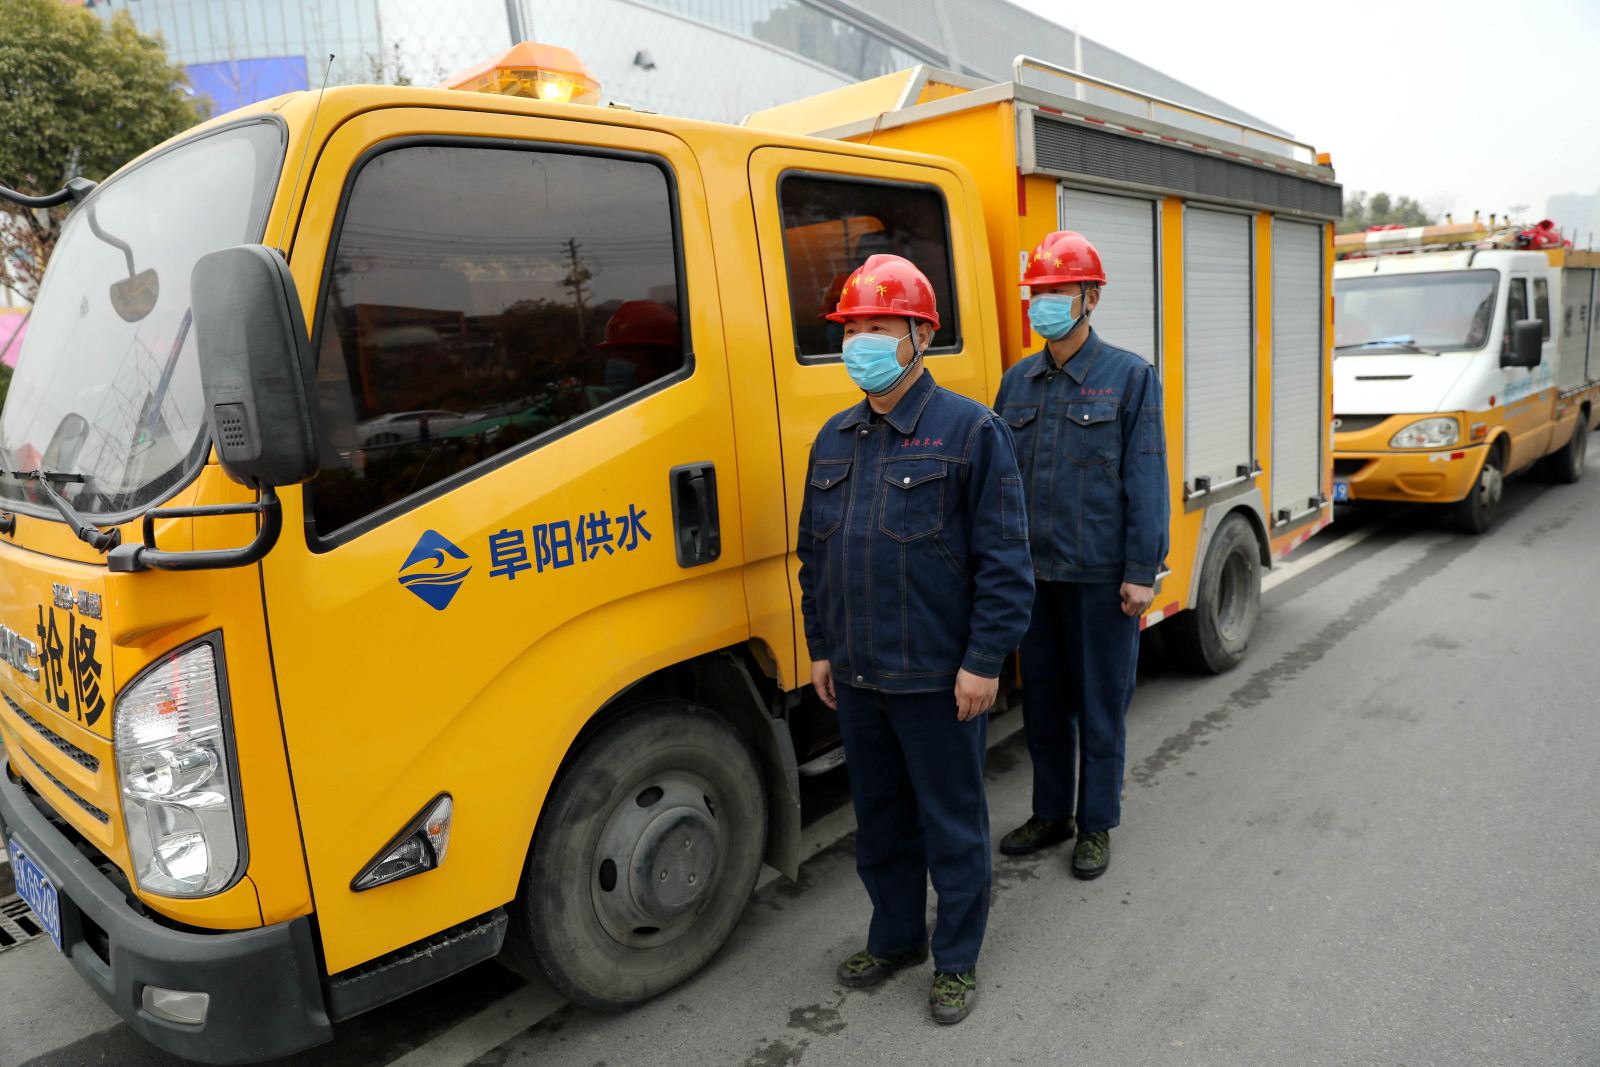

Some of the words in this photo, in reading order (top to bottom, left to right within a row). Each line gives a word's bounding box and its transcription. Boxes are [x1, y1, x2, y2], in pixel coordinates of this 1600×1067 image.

[488, 504, 652, 580] 阜阳供水
[37, 604, 106, 727] 抢修
